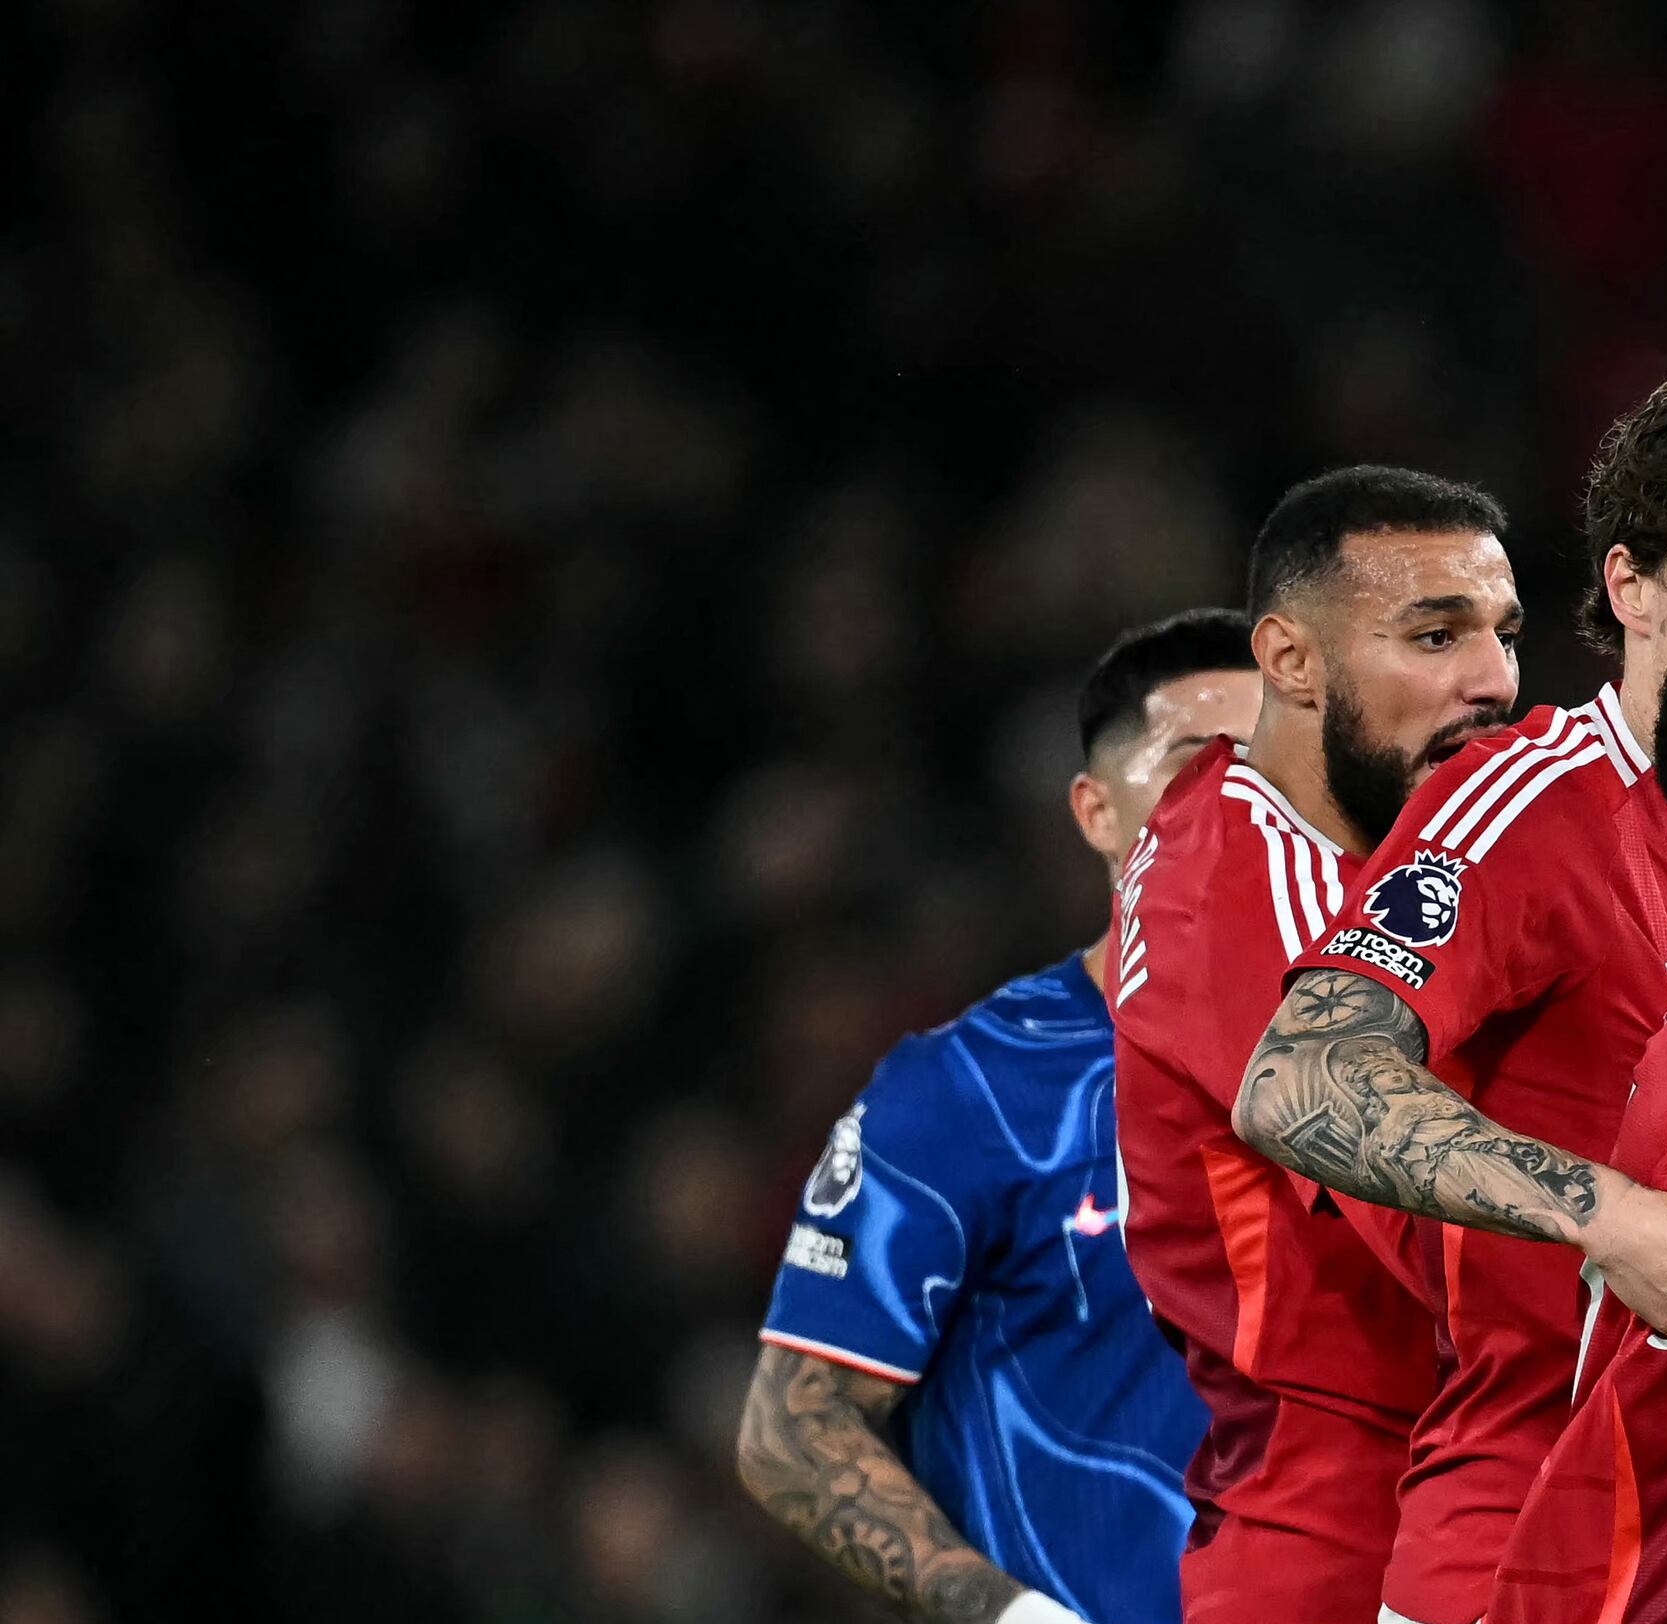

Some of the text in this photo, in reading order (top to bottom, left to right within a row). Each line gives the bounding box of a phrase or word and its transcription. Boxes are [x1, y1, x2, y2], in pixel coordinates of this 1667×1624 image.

[1331, 929, 1424, 973] No room
[1350, 945, 1424, 990] racism
